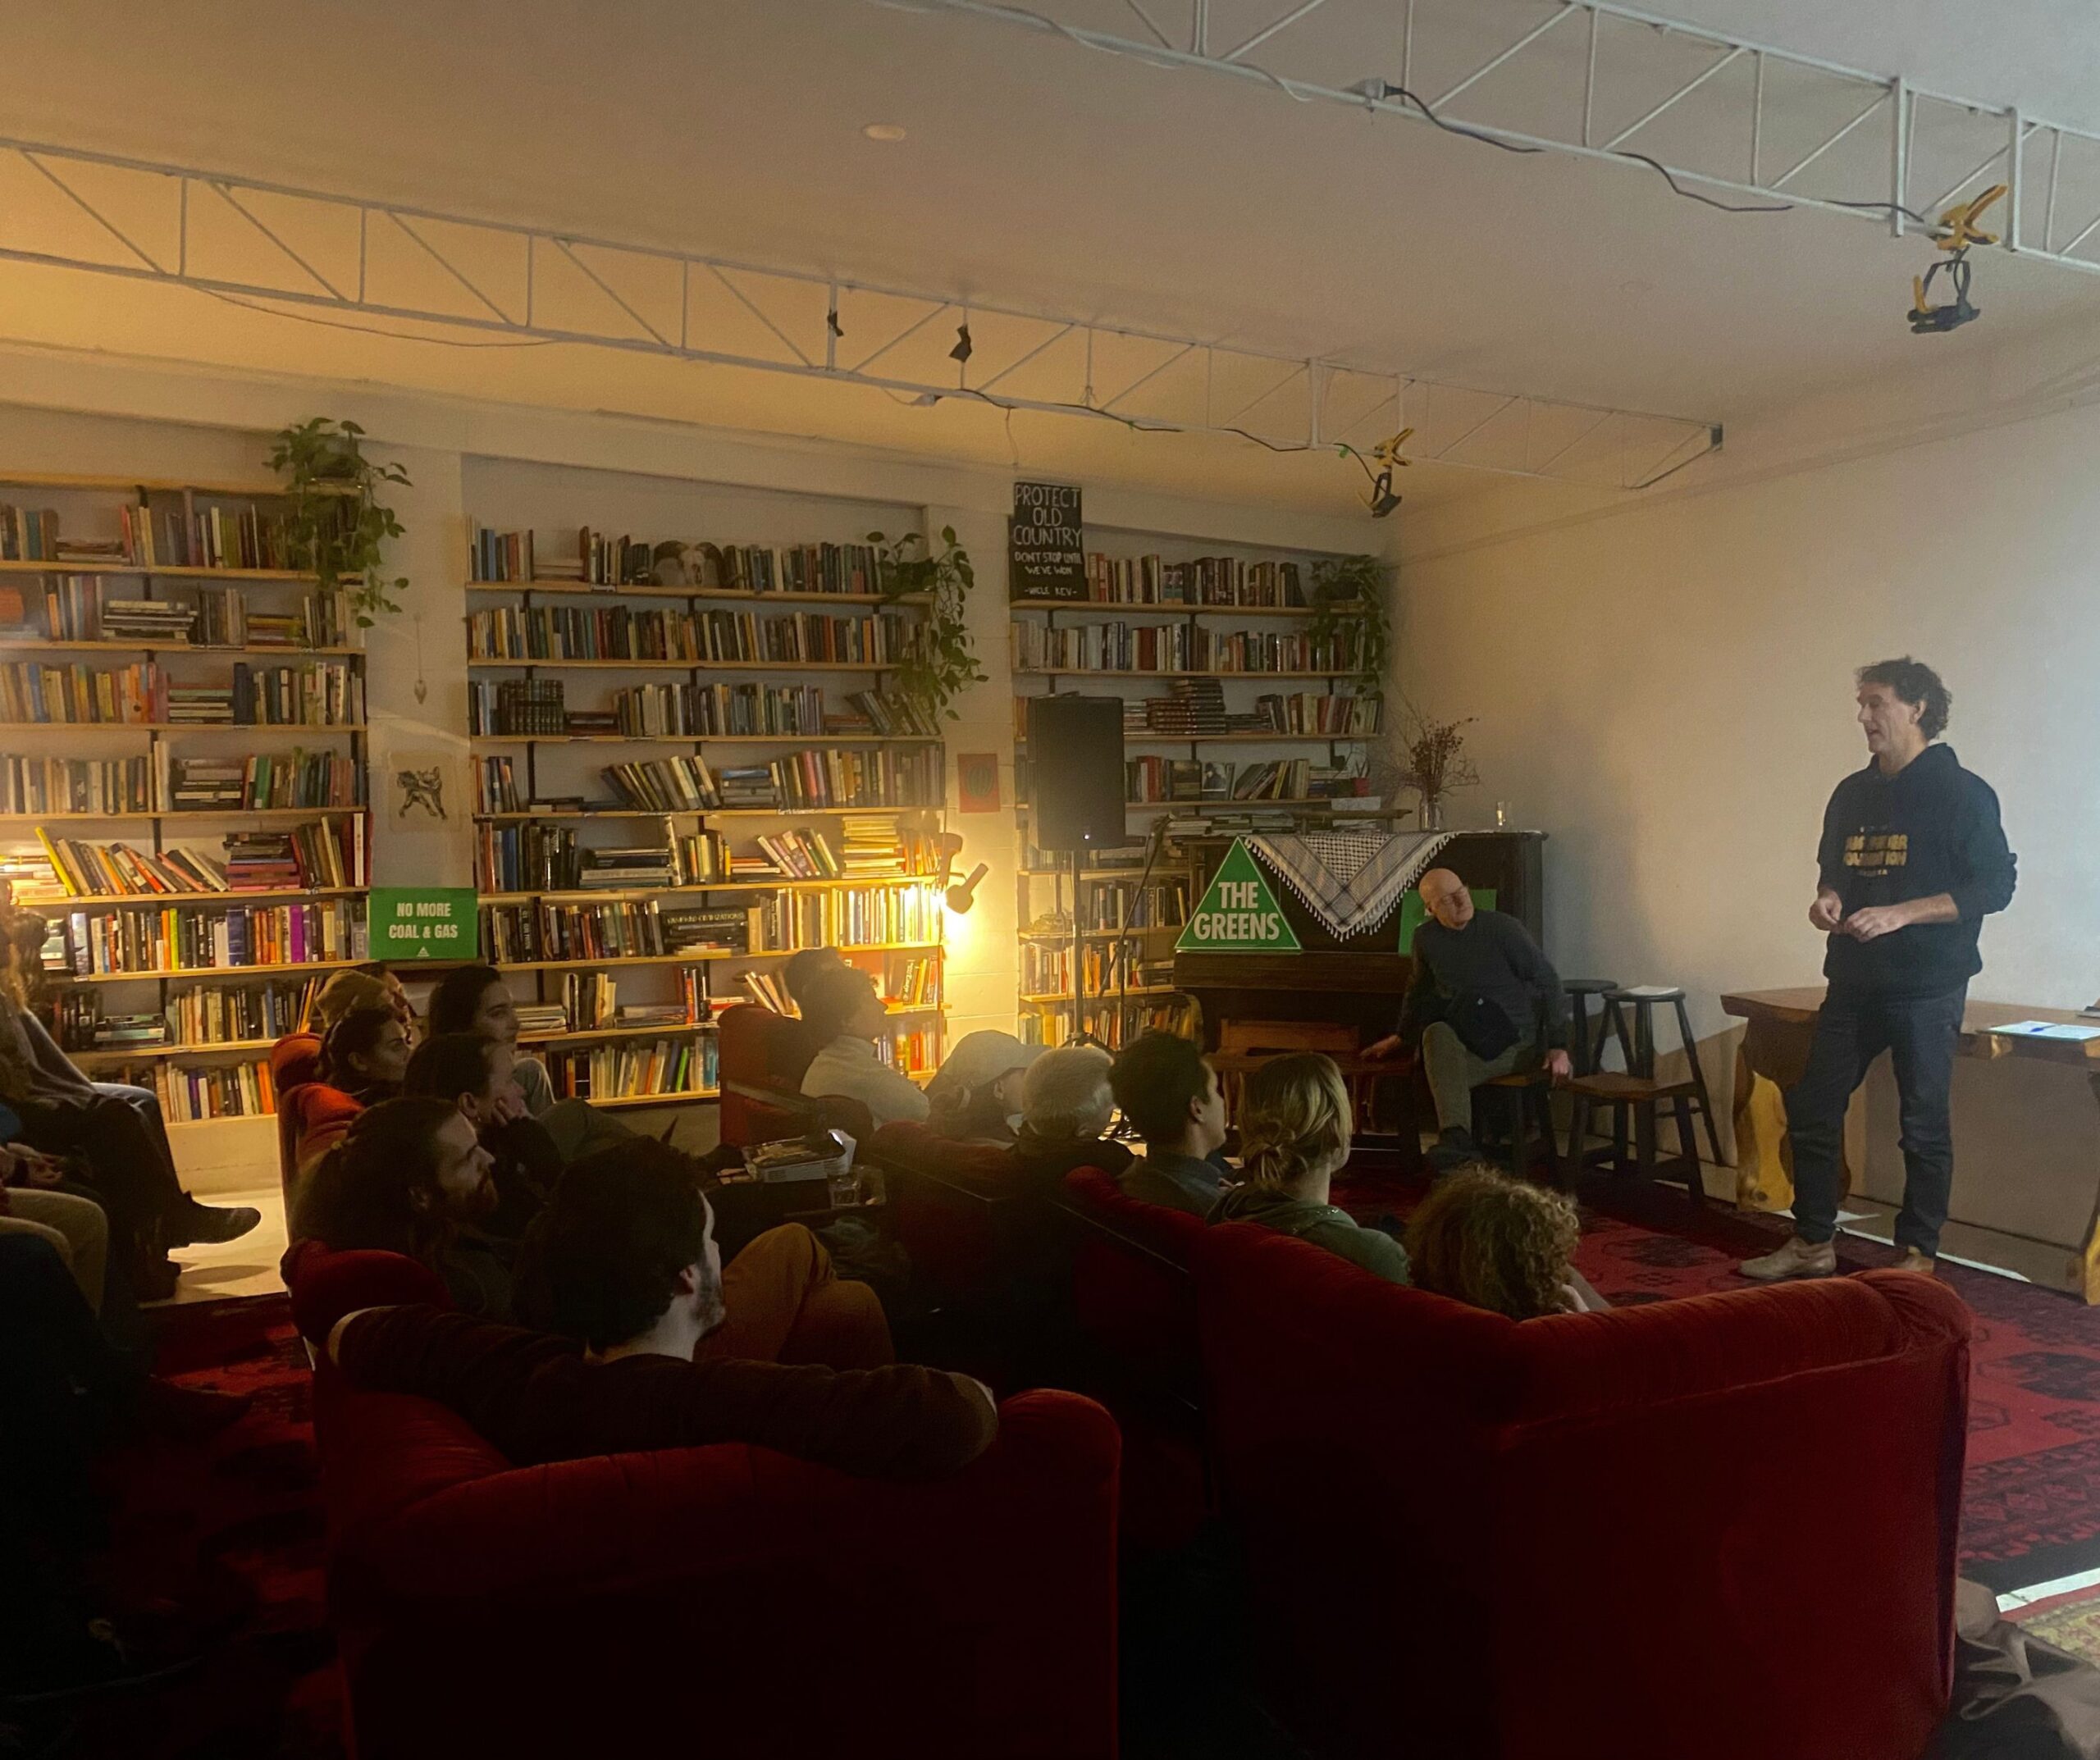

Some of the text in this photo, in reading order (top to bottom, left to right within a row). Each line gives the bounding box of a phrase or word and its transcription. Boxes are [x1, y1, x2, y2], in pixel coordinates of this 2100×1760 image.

[1015, 485, 1080, 508] PROTECT
[1033, 507, 1062, 527] OLD
[1013, 525, 1082, 547] COUNTRY
[1043, 552, 1061, 563] STOP
[1063, 553, 1083, 564] UNTIL
[1053, 566, 1073, 575] WON
[1218, 882, 1258, 909] THE
[397, 903, 451, 917] NO MORE
[389, 924, 458, 938] COAL & GAS
[1194, 913, 1280, 940] GREENS
